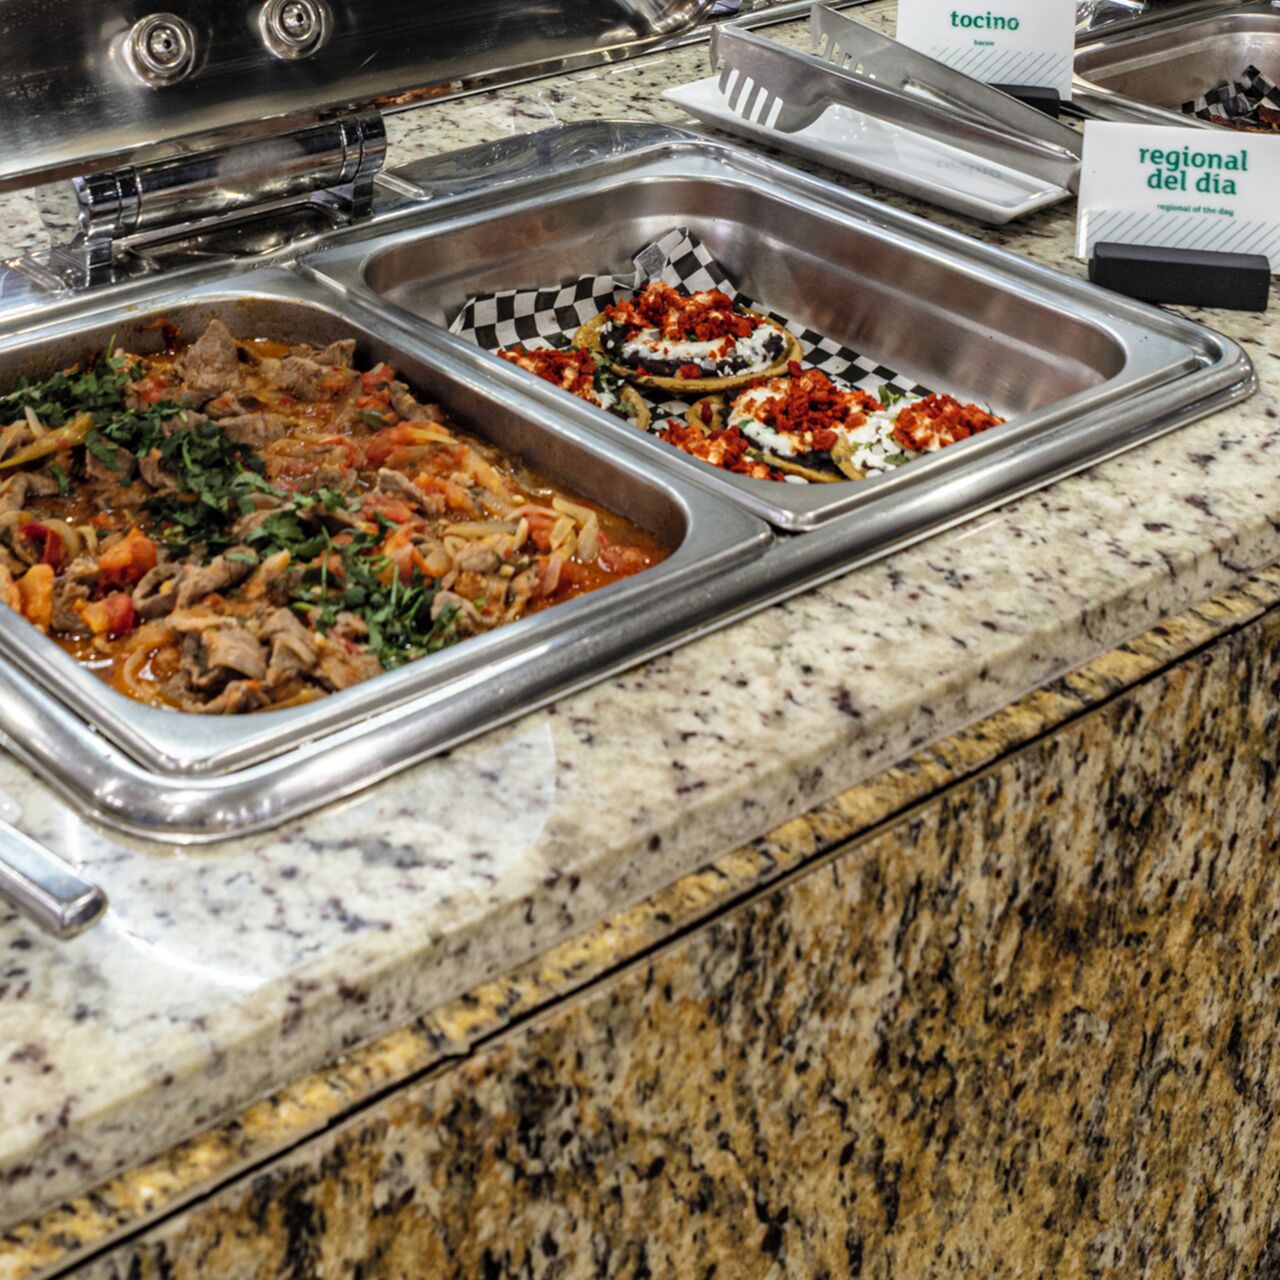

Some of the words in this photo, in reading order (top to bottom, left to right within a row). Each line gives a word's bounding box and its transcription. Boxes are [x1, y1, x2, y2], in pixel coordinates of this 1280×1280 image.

[950, 10, 1019, 31] tocino
[973, 39, 995, 47] bacon
[1139, 146, 1248, 171] regional
[1147, 169, 1187, 191] del
[1196, 172, 1237, 195] día
[1156, 204, 1191, 212] regional
[1218, 208, 1234, 217] day
